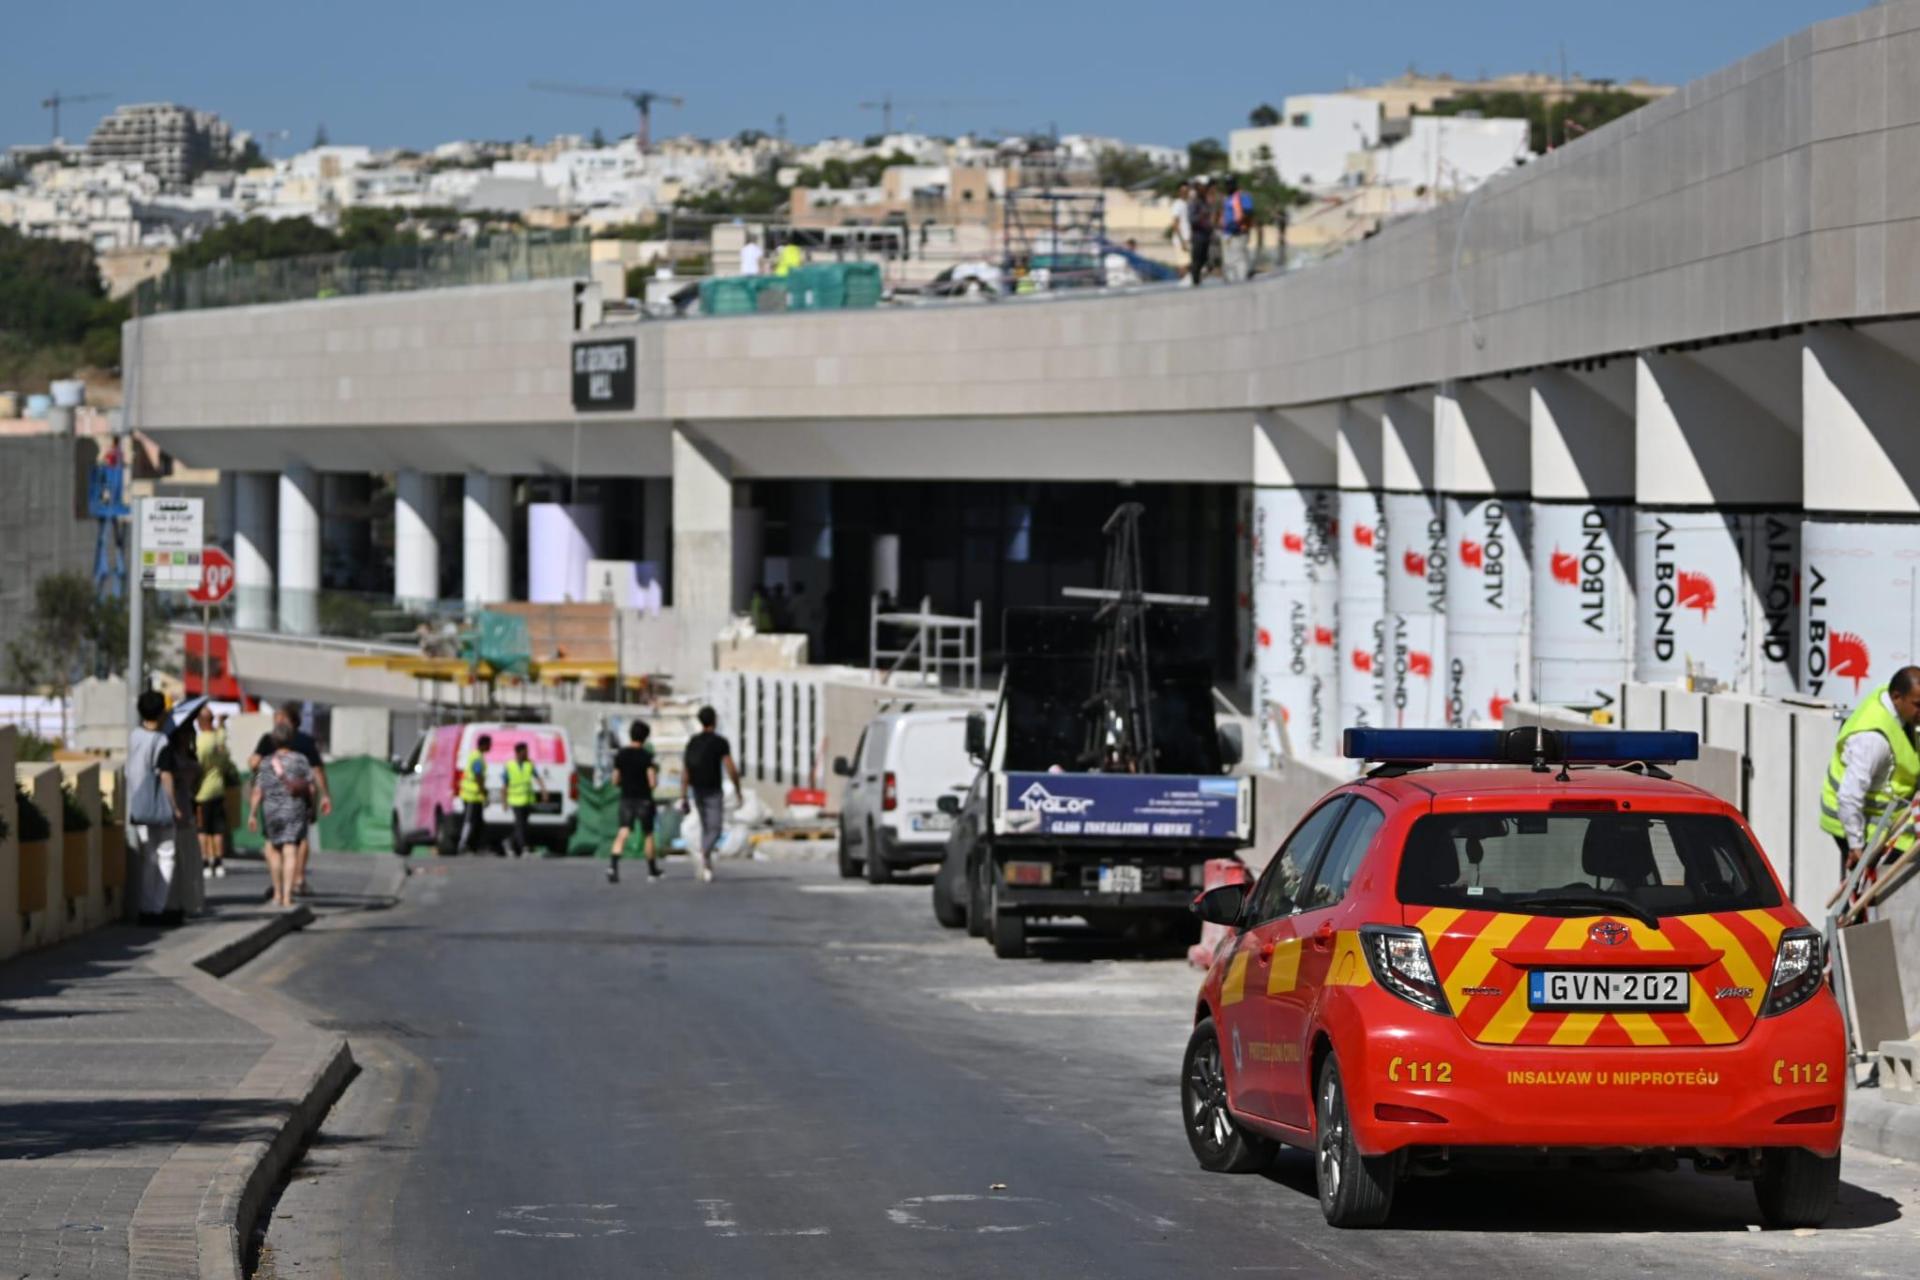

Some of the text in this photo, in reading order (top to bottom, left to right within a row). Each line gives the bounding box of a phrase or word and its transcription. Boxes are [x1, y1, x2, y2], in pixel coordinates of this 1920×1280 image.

[1428, 519, 1447, 614] ALBOND
[1484, 502, 1505, 609] ALBOND
[1581, 510, 1605, 632] ALBOND
[1655, 518, 1675, 662] ALBOND
[1766, 517, 1791, 663] ALBOND
[1395, 615, 1408, 708] ALBOND
[1406, 1062, 1453, 1082] 112
[1507, 1067, 1719, 1085] INSALVAW U NIPPROTEĠU
[1788, 1062, 1829, 1083] 112
